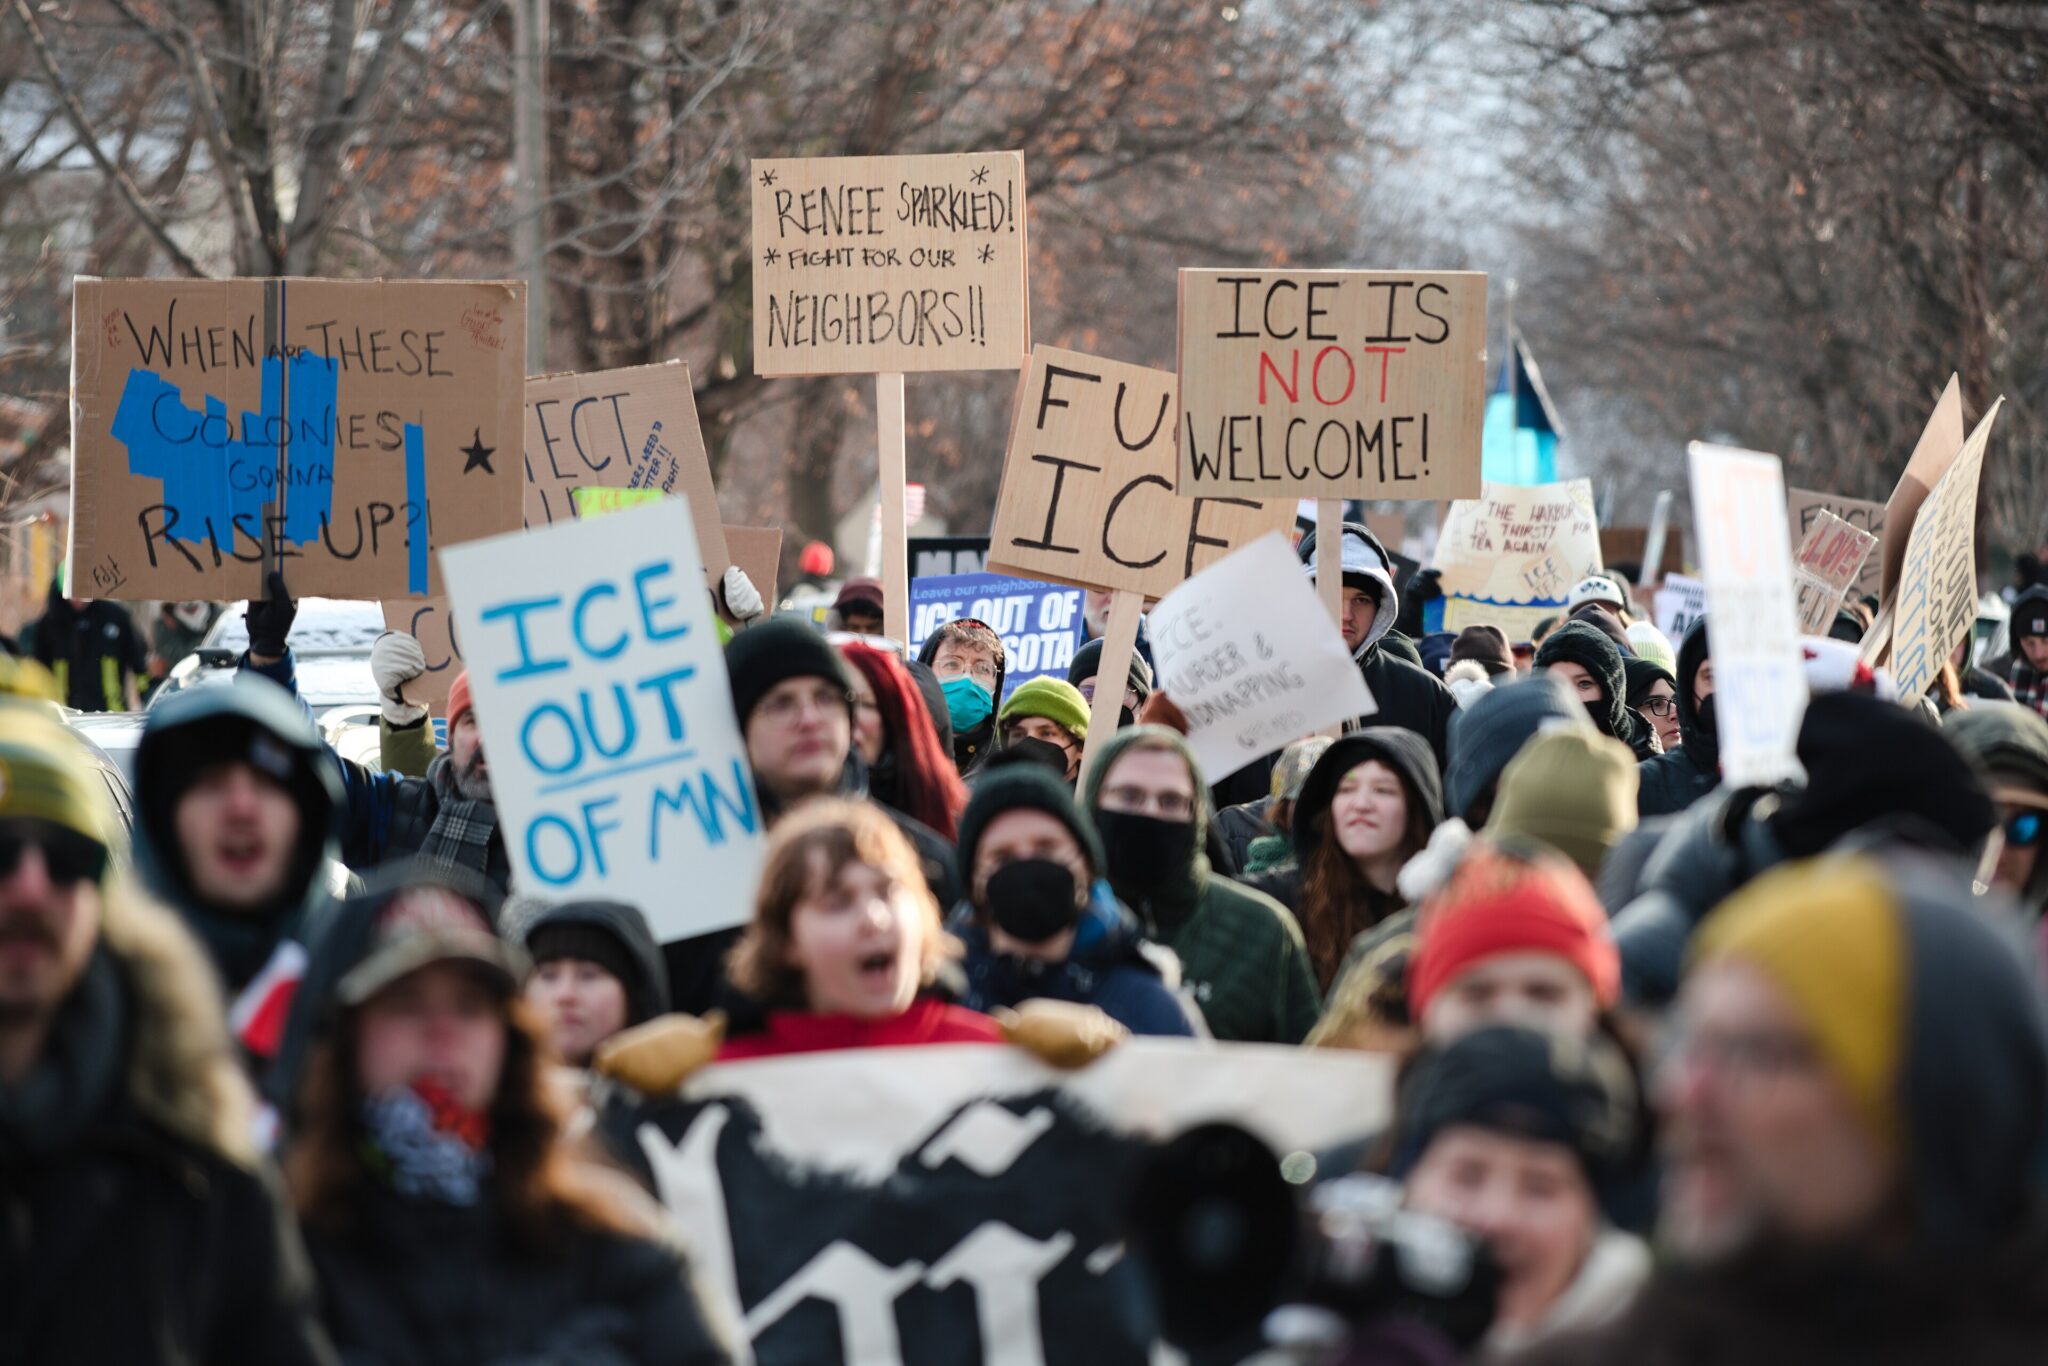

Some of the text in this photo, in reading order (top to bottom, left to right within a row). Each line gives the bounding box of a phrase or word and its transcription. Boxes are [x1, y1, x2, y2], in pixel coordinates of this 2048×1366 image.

[775, 179, 1015, 237] RENEE SPARKLED!
[788, 247, 956, 269] FIGHT FOR OUR
[123, 298, 256, 373] WHEN
[305, 320, 453, 378] THESE
[768, 284, 986, 349] NEIGHBORS!!
[1216, 277, 1450, 345] ICE IS
[1036, 363, 1178, 452] FU
[1258, 345, 1406, 405] NOT
[525, 392, 633, 483] ECT
[641, 433, 659, 462] NEED
[1186, 411, 1431, 484] WELCOME!
[228, 457, 336, 492] GONNA
[138, 504, 304, 573] RISE
[1473, 518, 1488, 537] IS
[1500, 522, 1557, 540] THIRSTY
[1488, 500, 1517, 521] THE
[1469, 533, 1548, 554] TEA AGAIN
[480, 558, 692, 685] ICE
[913, 587, 952, 600] Leave
[954, 584, 978, 597] our
[970, 594, 1034, 636] OUT
[1038, 590, 1081, 631] OF
[519, 664, 698, 776] OUT
[1187, 660, 1306, 732] IDNAPPING
[524, 757, 760, 888] OF MN
